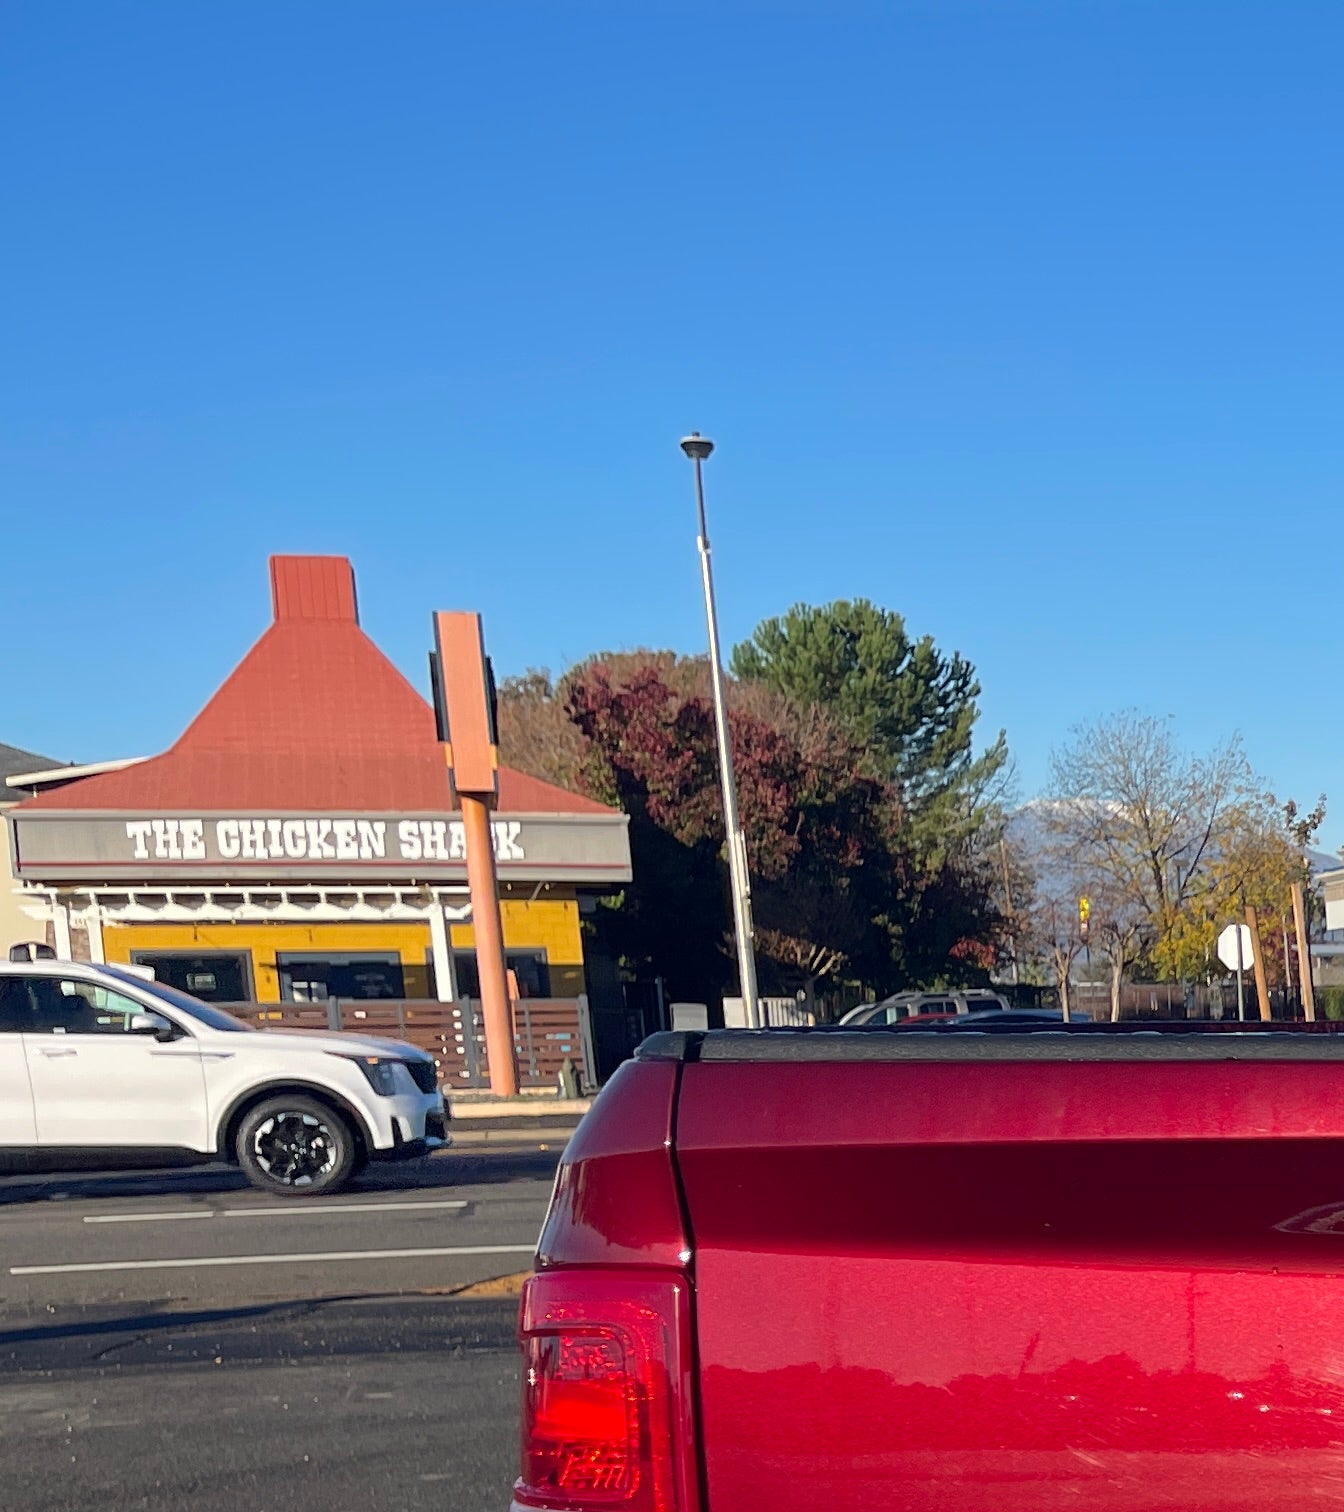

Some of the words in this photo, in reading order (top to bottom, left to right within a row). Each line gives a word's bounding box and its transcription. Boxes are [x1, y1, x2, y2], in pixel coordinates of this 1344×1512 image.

[126, 819, 206, 860] THE
[216, 820, 386, 860] CHICKEN
[398, 820, 525, 861] SHAK
